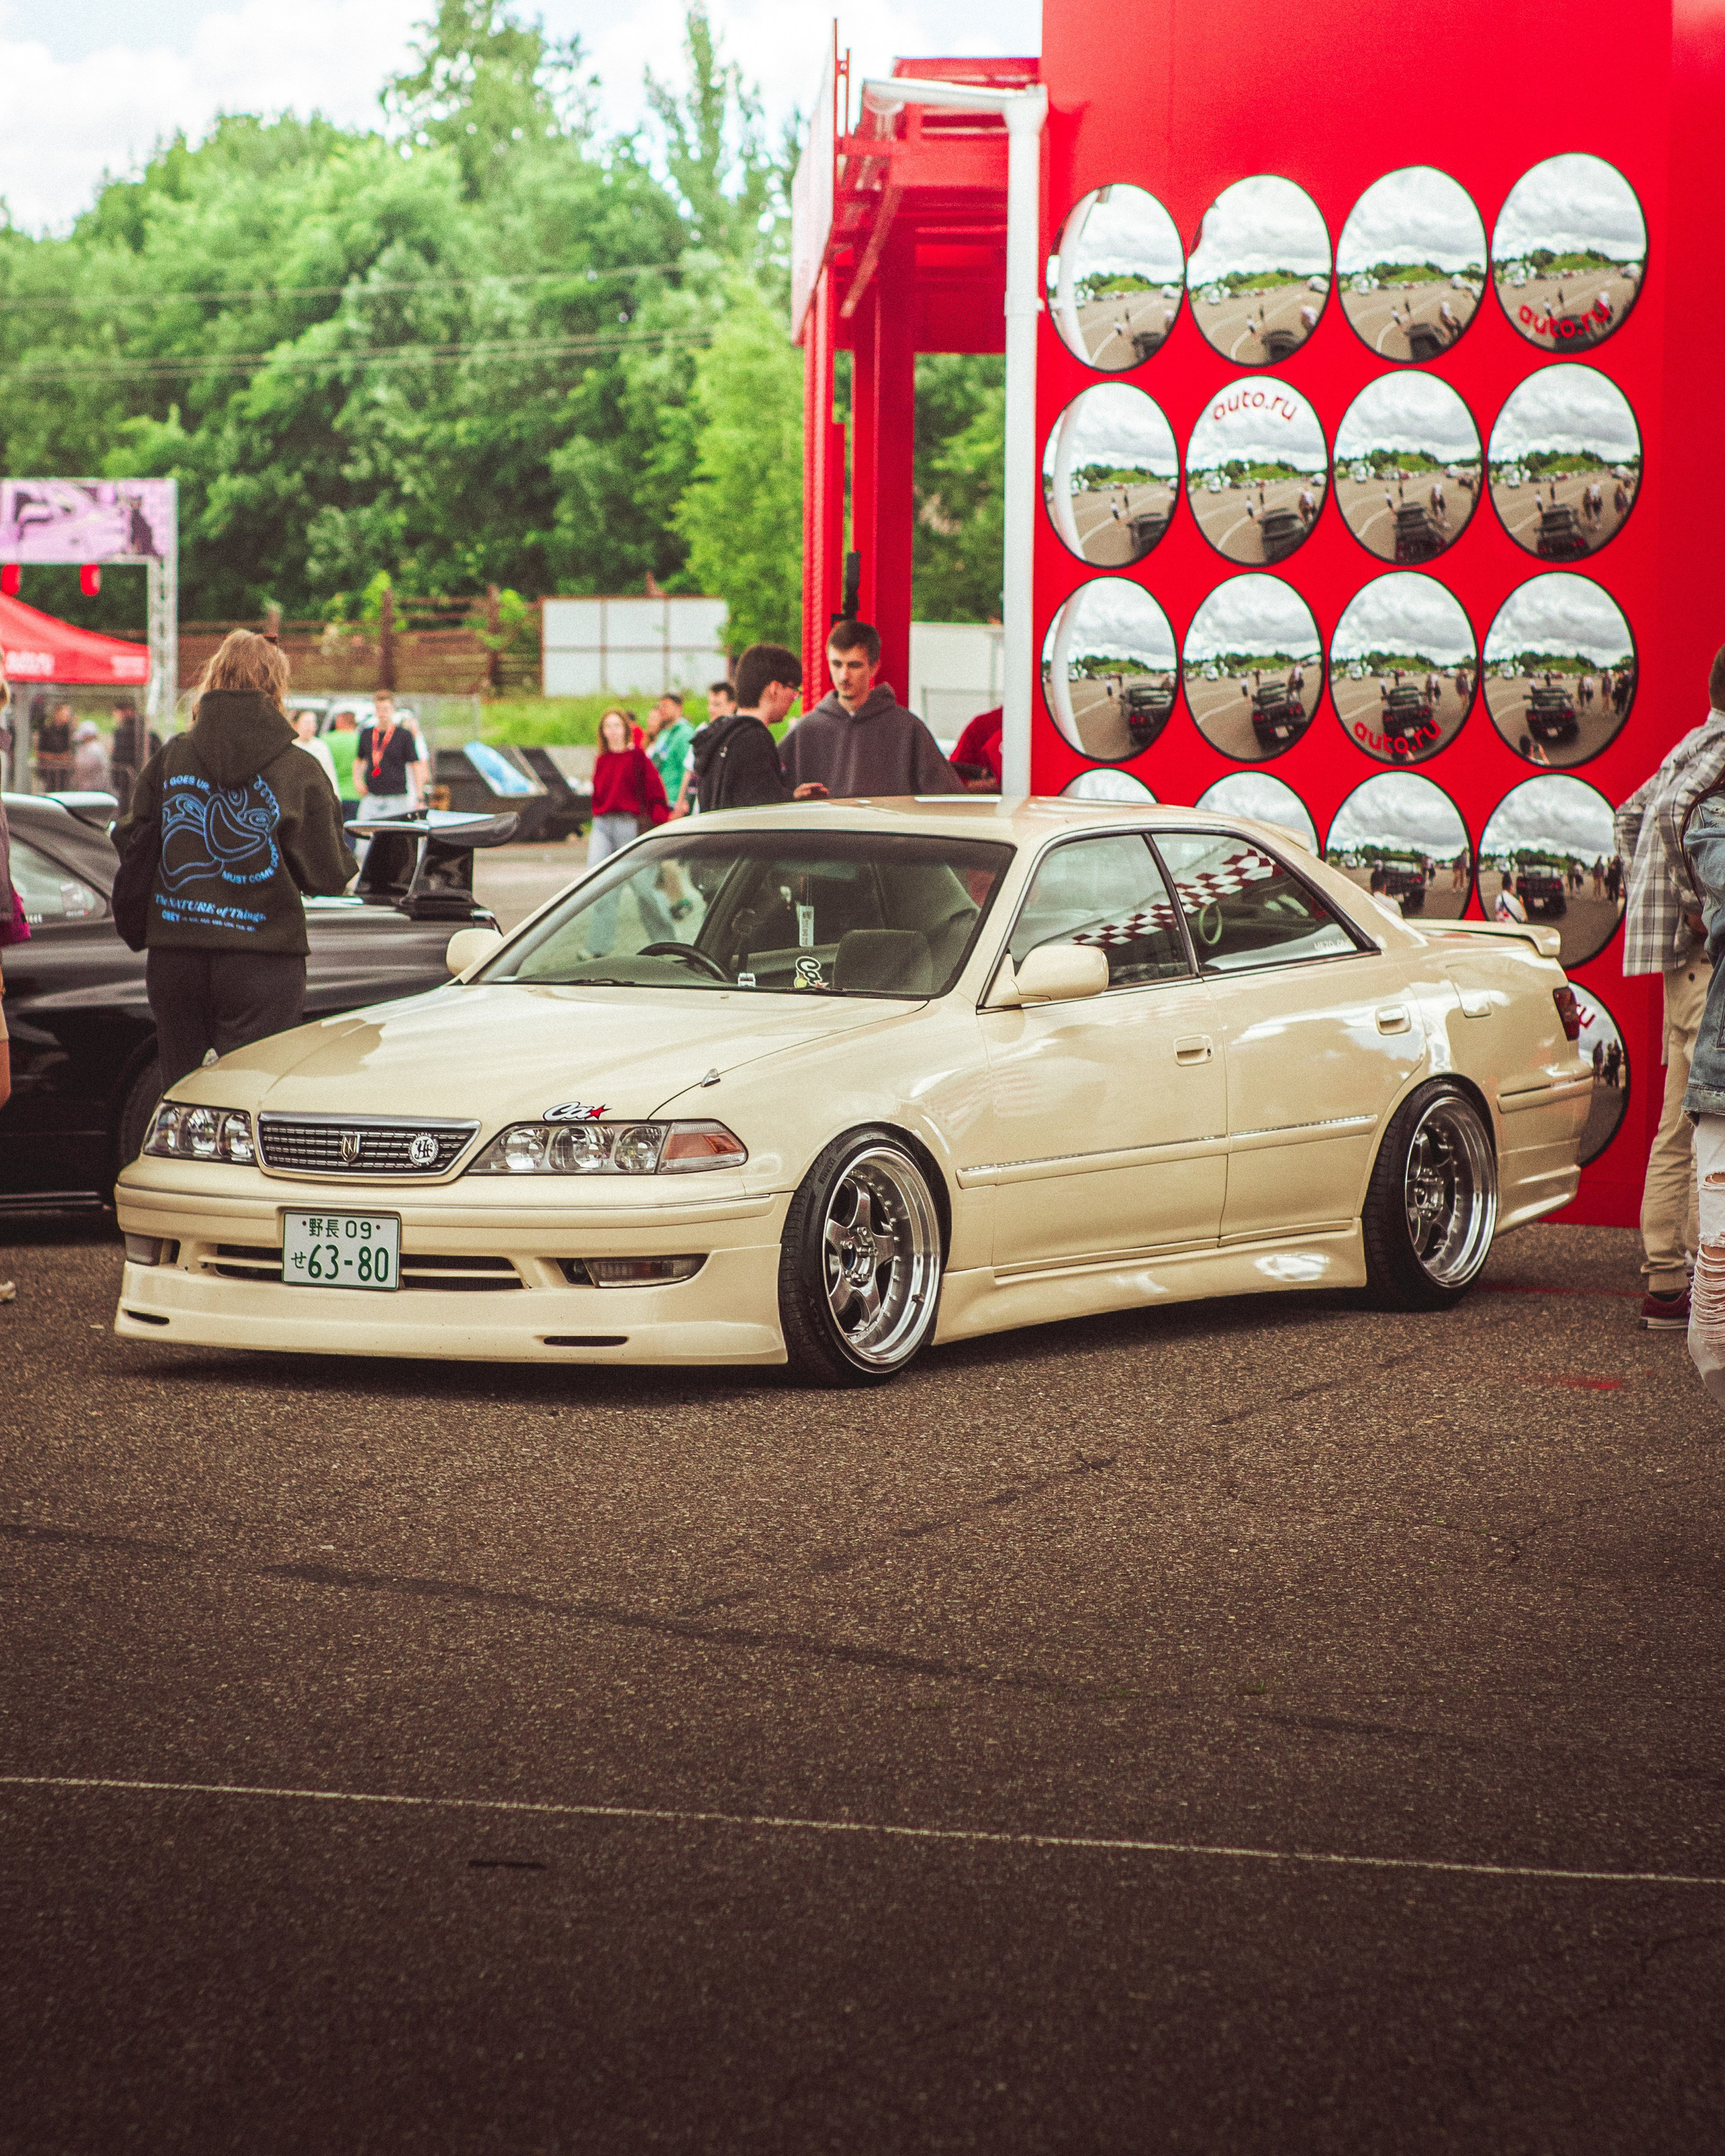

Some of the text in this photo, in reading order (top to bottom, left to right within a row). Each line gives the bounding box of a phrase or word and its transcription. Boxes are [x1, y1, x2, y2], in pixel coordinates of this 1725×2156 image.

[1519, 300, 1610, 338] auto.ru
[1214, 391, 1297, 420] auto.ru
[1354, 718, 1442, 754] auto.ru
[222, 870, 247, 885] MUST
[249, 866, 274, 883] COME
[309, 1218, 372, 1240] 野長 09
[290, 1244, 389, 1282] せ 63-80
